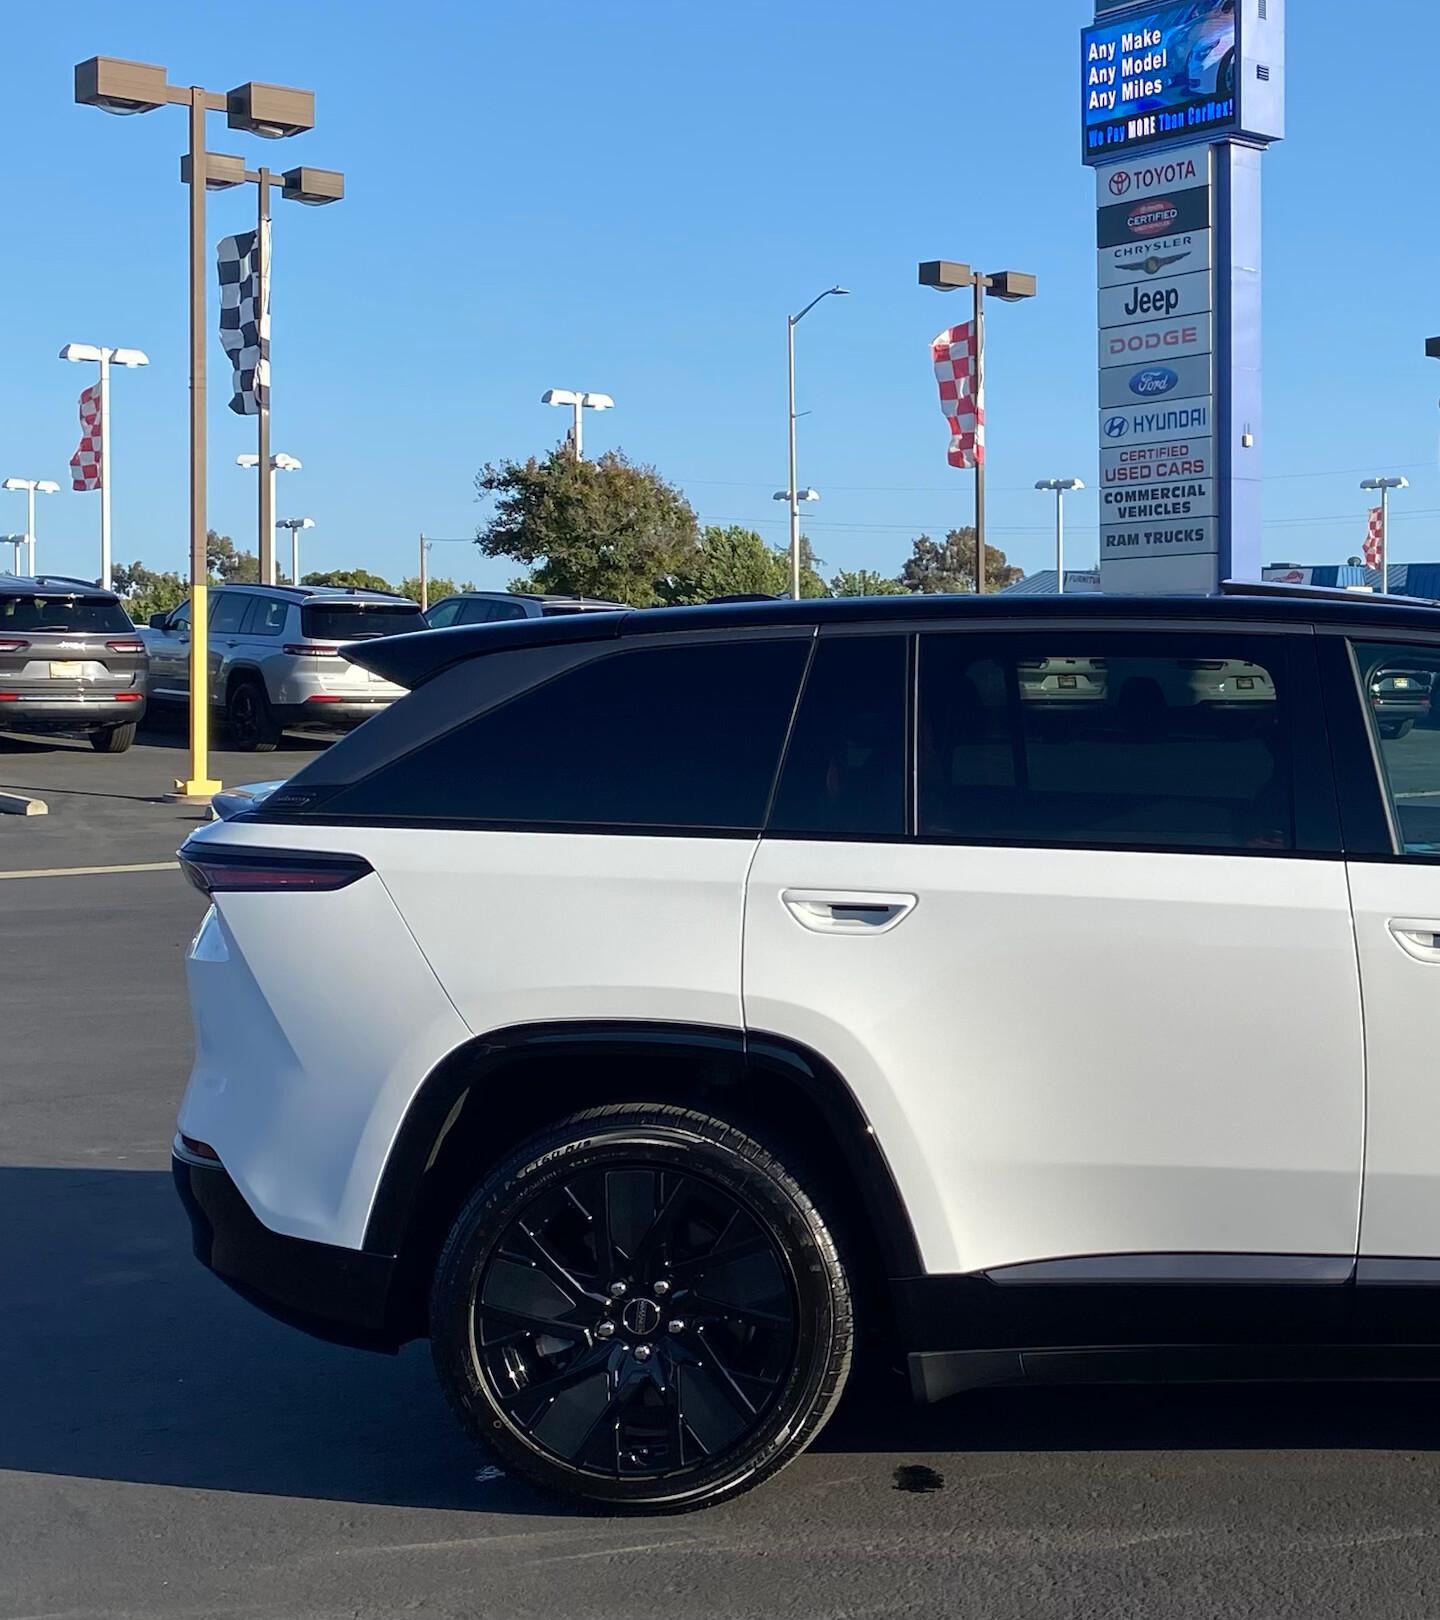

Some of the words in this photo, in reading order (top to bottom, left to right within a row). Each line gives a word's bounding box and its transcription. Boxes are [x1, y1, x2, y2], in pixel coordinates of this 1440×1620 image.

[1088, 41, 1116, 62] Any
[1121, 29, 1161, 53] Make
[1088, 65, 1116, 86] Any
[1121, 49, 1167, 77] Model
[1088, 89, 1116, 110] Any
[1121, 77, 1162, 102] Miles
[1107, 125, 1125, 144] Pay
[1128, 116, 1156, 139] MORE
[1159, 111, 1184, 132] Than
[1134, 160, 1196, 190] TOYOTA
[1127, 209, 1178, 227] CERTIFIED
[1114, 236, 1192, 258] CHRYSLER
[1124, 286, 1179, 316] Jeep
[1109, 327, 1198, 355] DODGE
[1138, 371, 1168, 392] Ford
[1133, 407, 1206, 435] HYUNDAI
[1119, 444, 1189, 463] CERTIFIED
[1105, 465, 1151, 483] USED
[1156, 459, 1205, 477] CARS
[1104, 484, 1206, 504] COMMERCIAL
[1117, 501, 1192, 519] VEHICLES
[1106, 533, 1140, 548] RAM
[1143, 528, 1205, 545] TRUCKS
